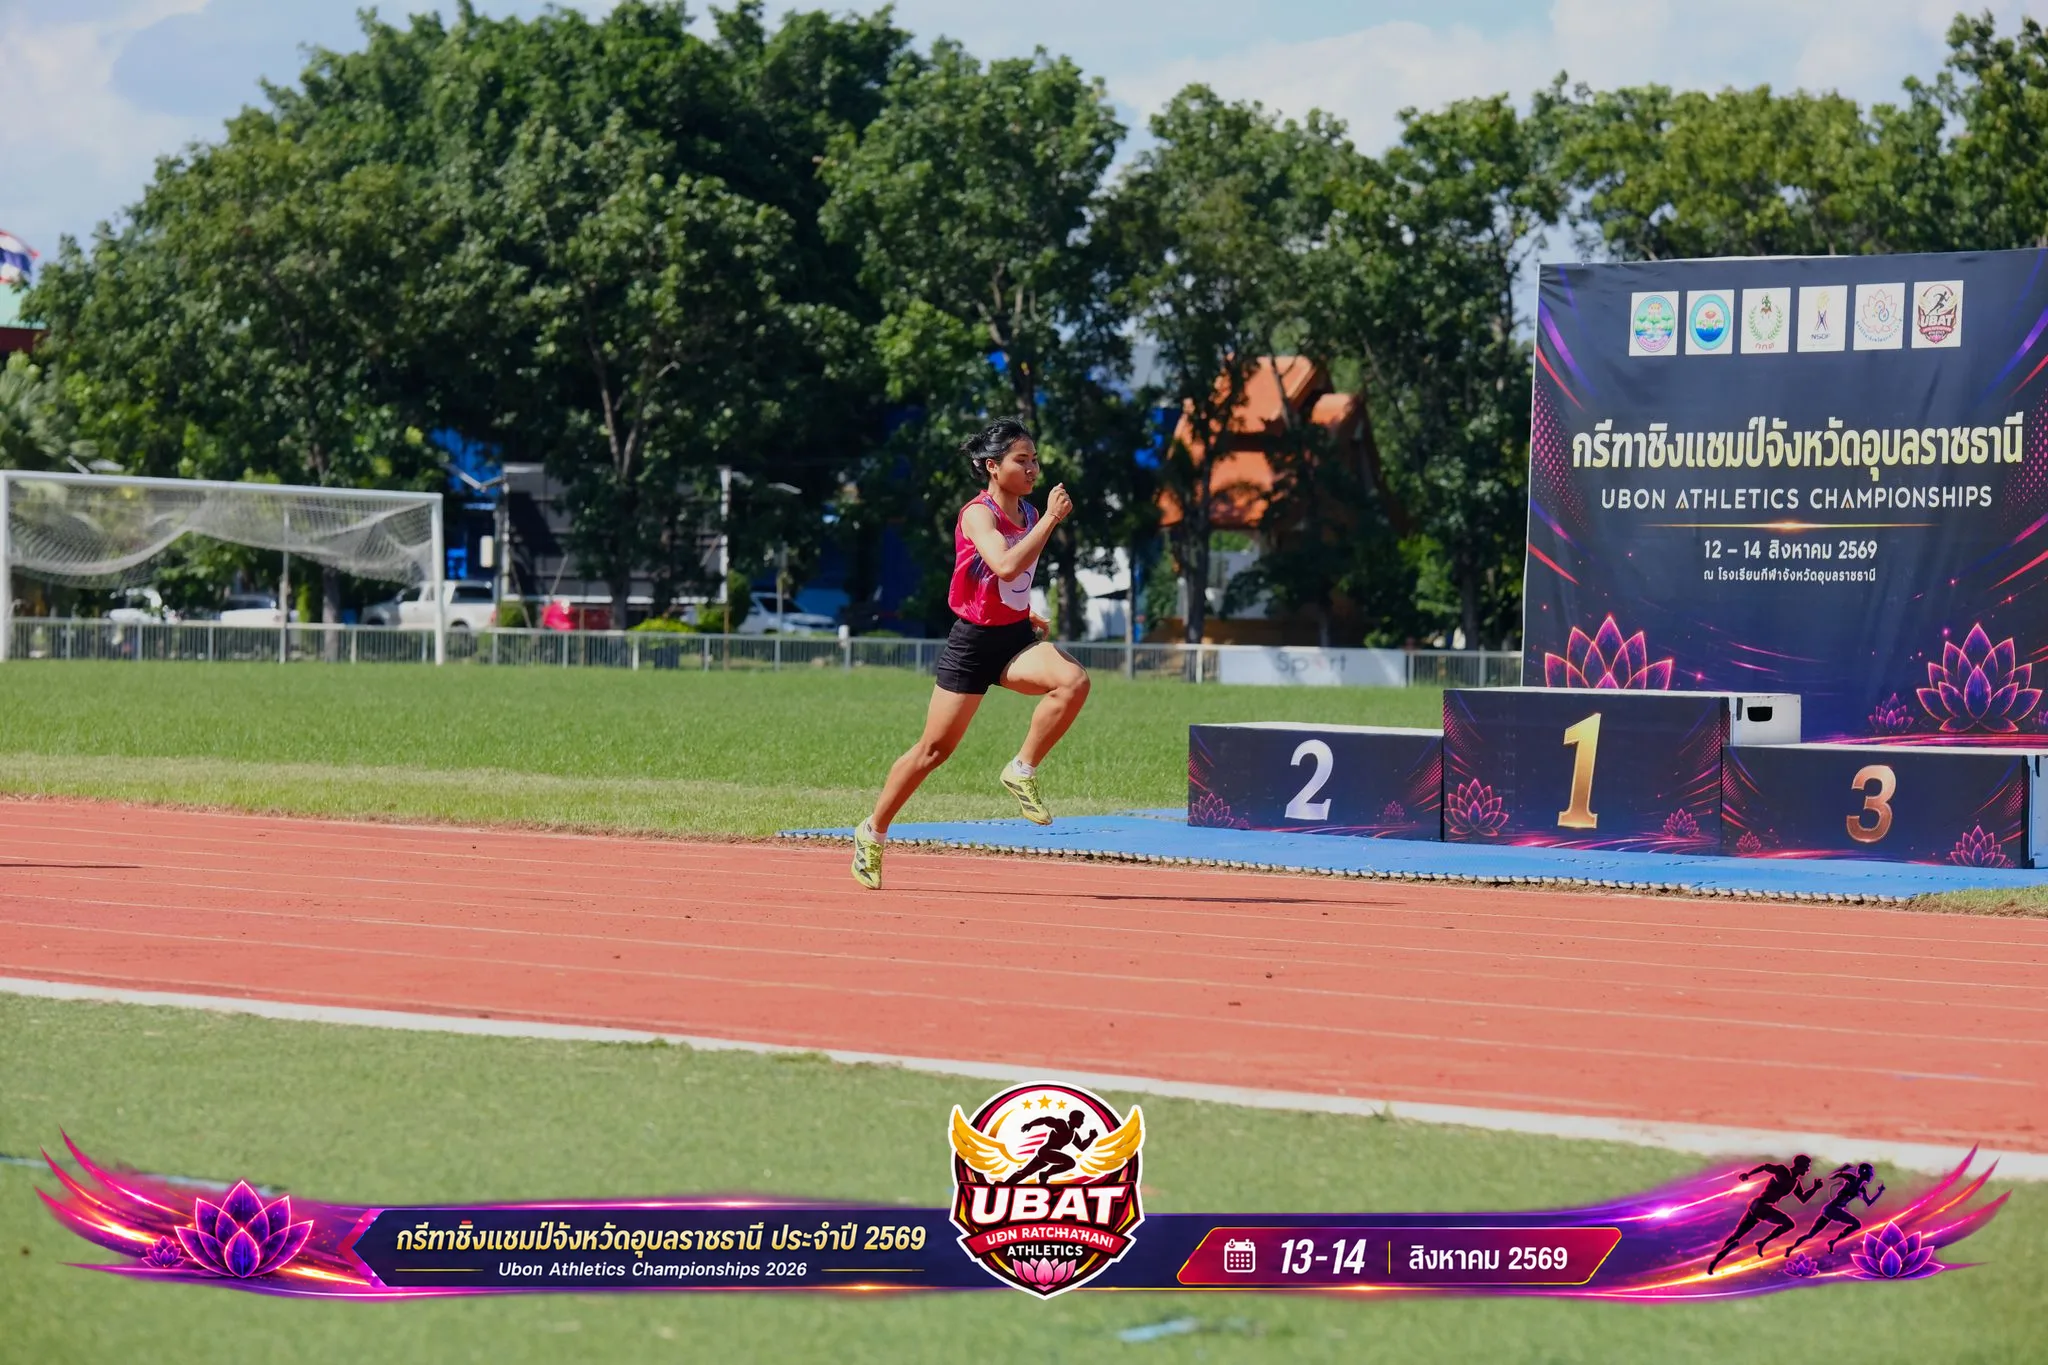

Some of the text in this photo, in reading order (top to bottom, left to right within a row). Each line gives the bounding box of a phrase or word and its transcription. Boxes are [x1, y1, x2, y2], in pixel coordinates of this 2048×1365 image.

[1920, 314, 1953, 327] UBAT
[1572, 411, 2024, 482] กรีฑาชิงแชมป์จังหวัดอุบลราชธานี
[1601, 485, 1992, 509] UBON ATHLETICS CHAMPIONSHIPS
[1704, 540, 1722, 559] 12
[1743, 540, 1761, 559] 14
[1768, 539, 1832, 560] สิงหาคม
[1838, 540, 1878, 560] 2569
[1704, 566, 1876, 585] ณ โรงเรียนกีฬาจังหวัดอุบลราชธานี
[1285, 739, 1334, 821] 2
[1557, 712, 1602, 829] 1
[1846, 764, 1896, 844] 3
